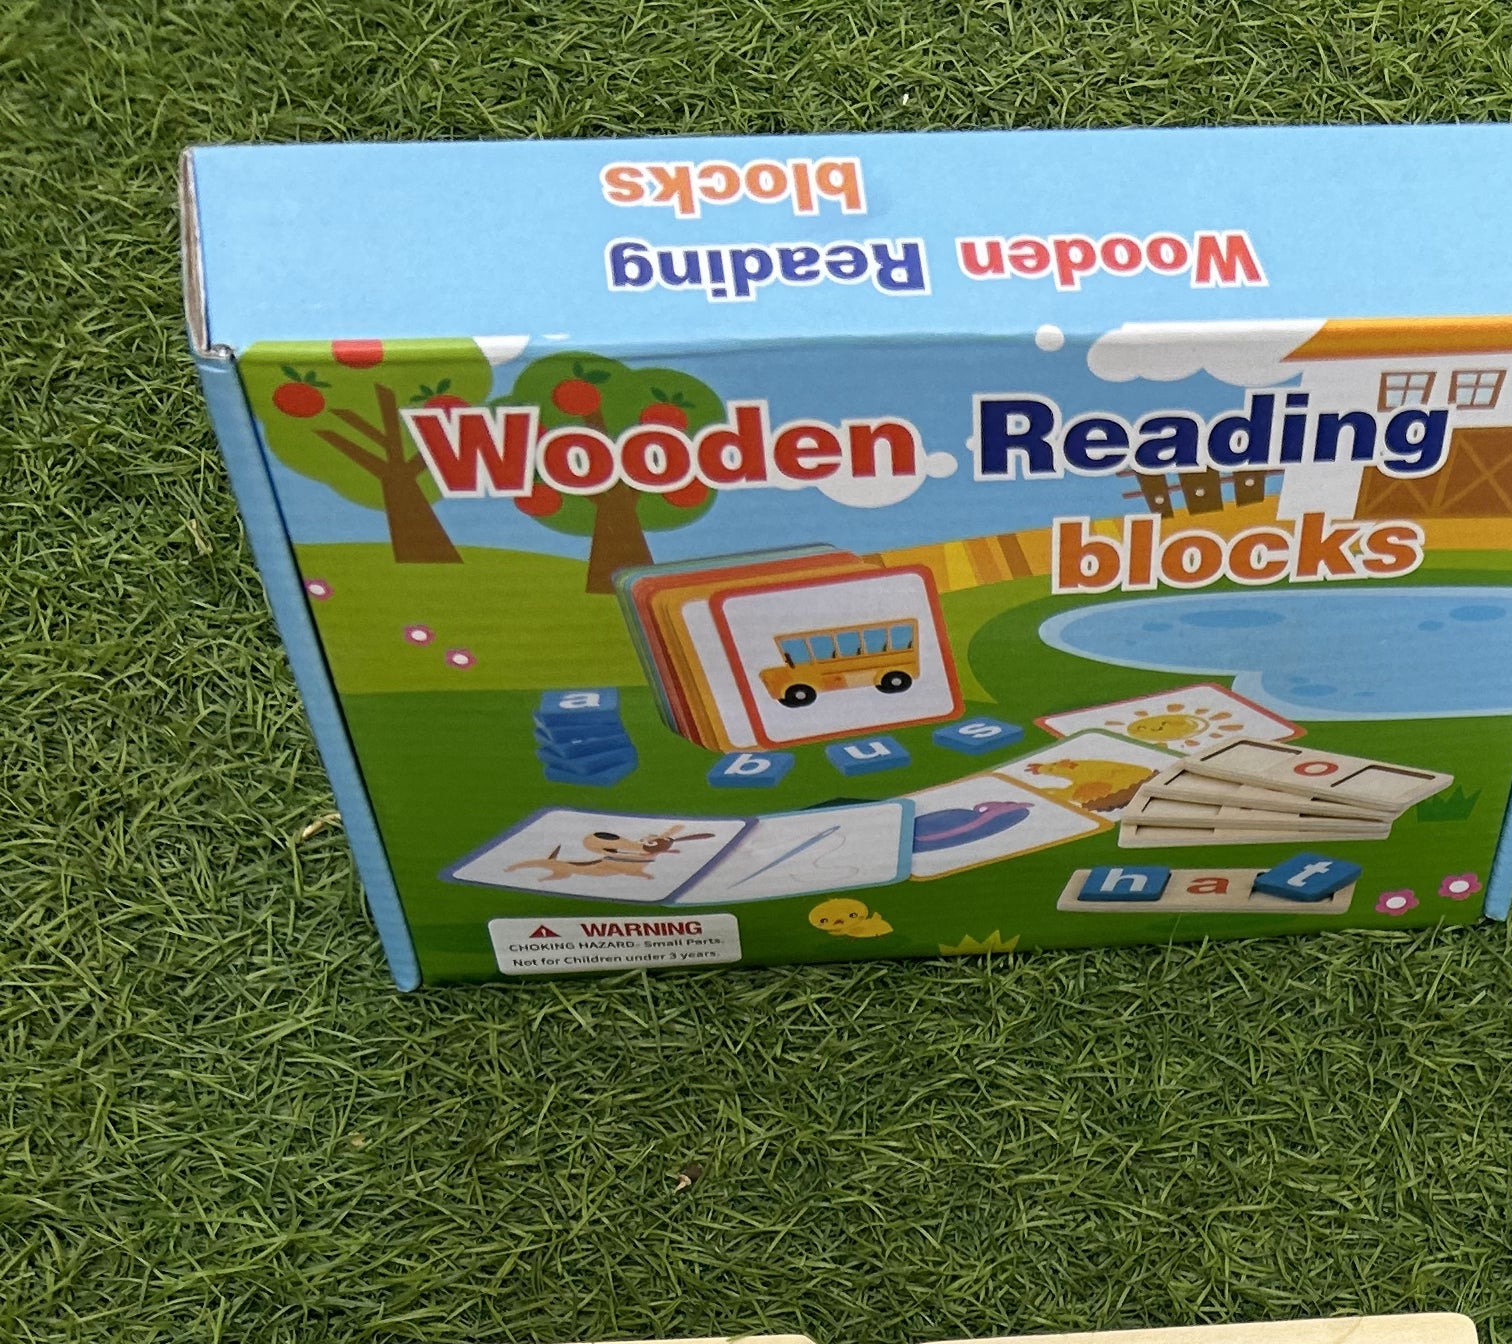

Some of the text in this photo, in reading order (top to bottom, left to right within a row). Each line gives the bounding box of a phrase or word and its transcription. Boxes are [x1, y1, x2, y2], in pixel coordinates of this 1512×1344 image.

[604, 160, 865, 215] blocks
[609, 232, 1266, 299] Wooden Reading
[410, 393, 1450, 494] Wooden Reading
[1054, 512, 1422, 592] blocks
[558, 692, 601, 709] a
[723, 717, 1002, 777] b u s
[1294, 760, 1339, 777] o
[509, 942, 575, 953] CHOKING
[644, 938, 682, 948] Small
[580, 920, 703, 938] WARNING
[513, 958, 537, 967] Not
[541, 957, 561, 966] for
[564, 954, 622, 965] Children
[626, 952, 665, 963] under
[669, 951, 678, 960] 3
